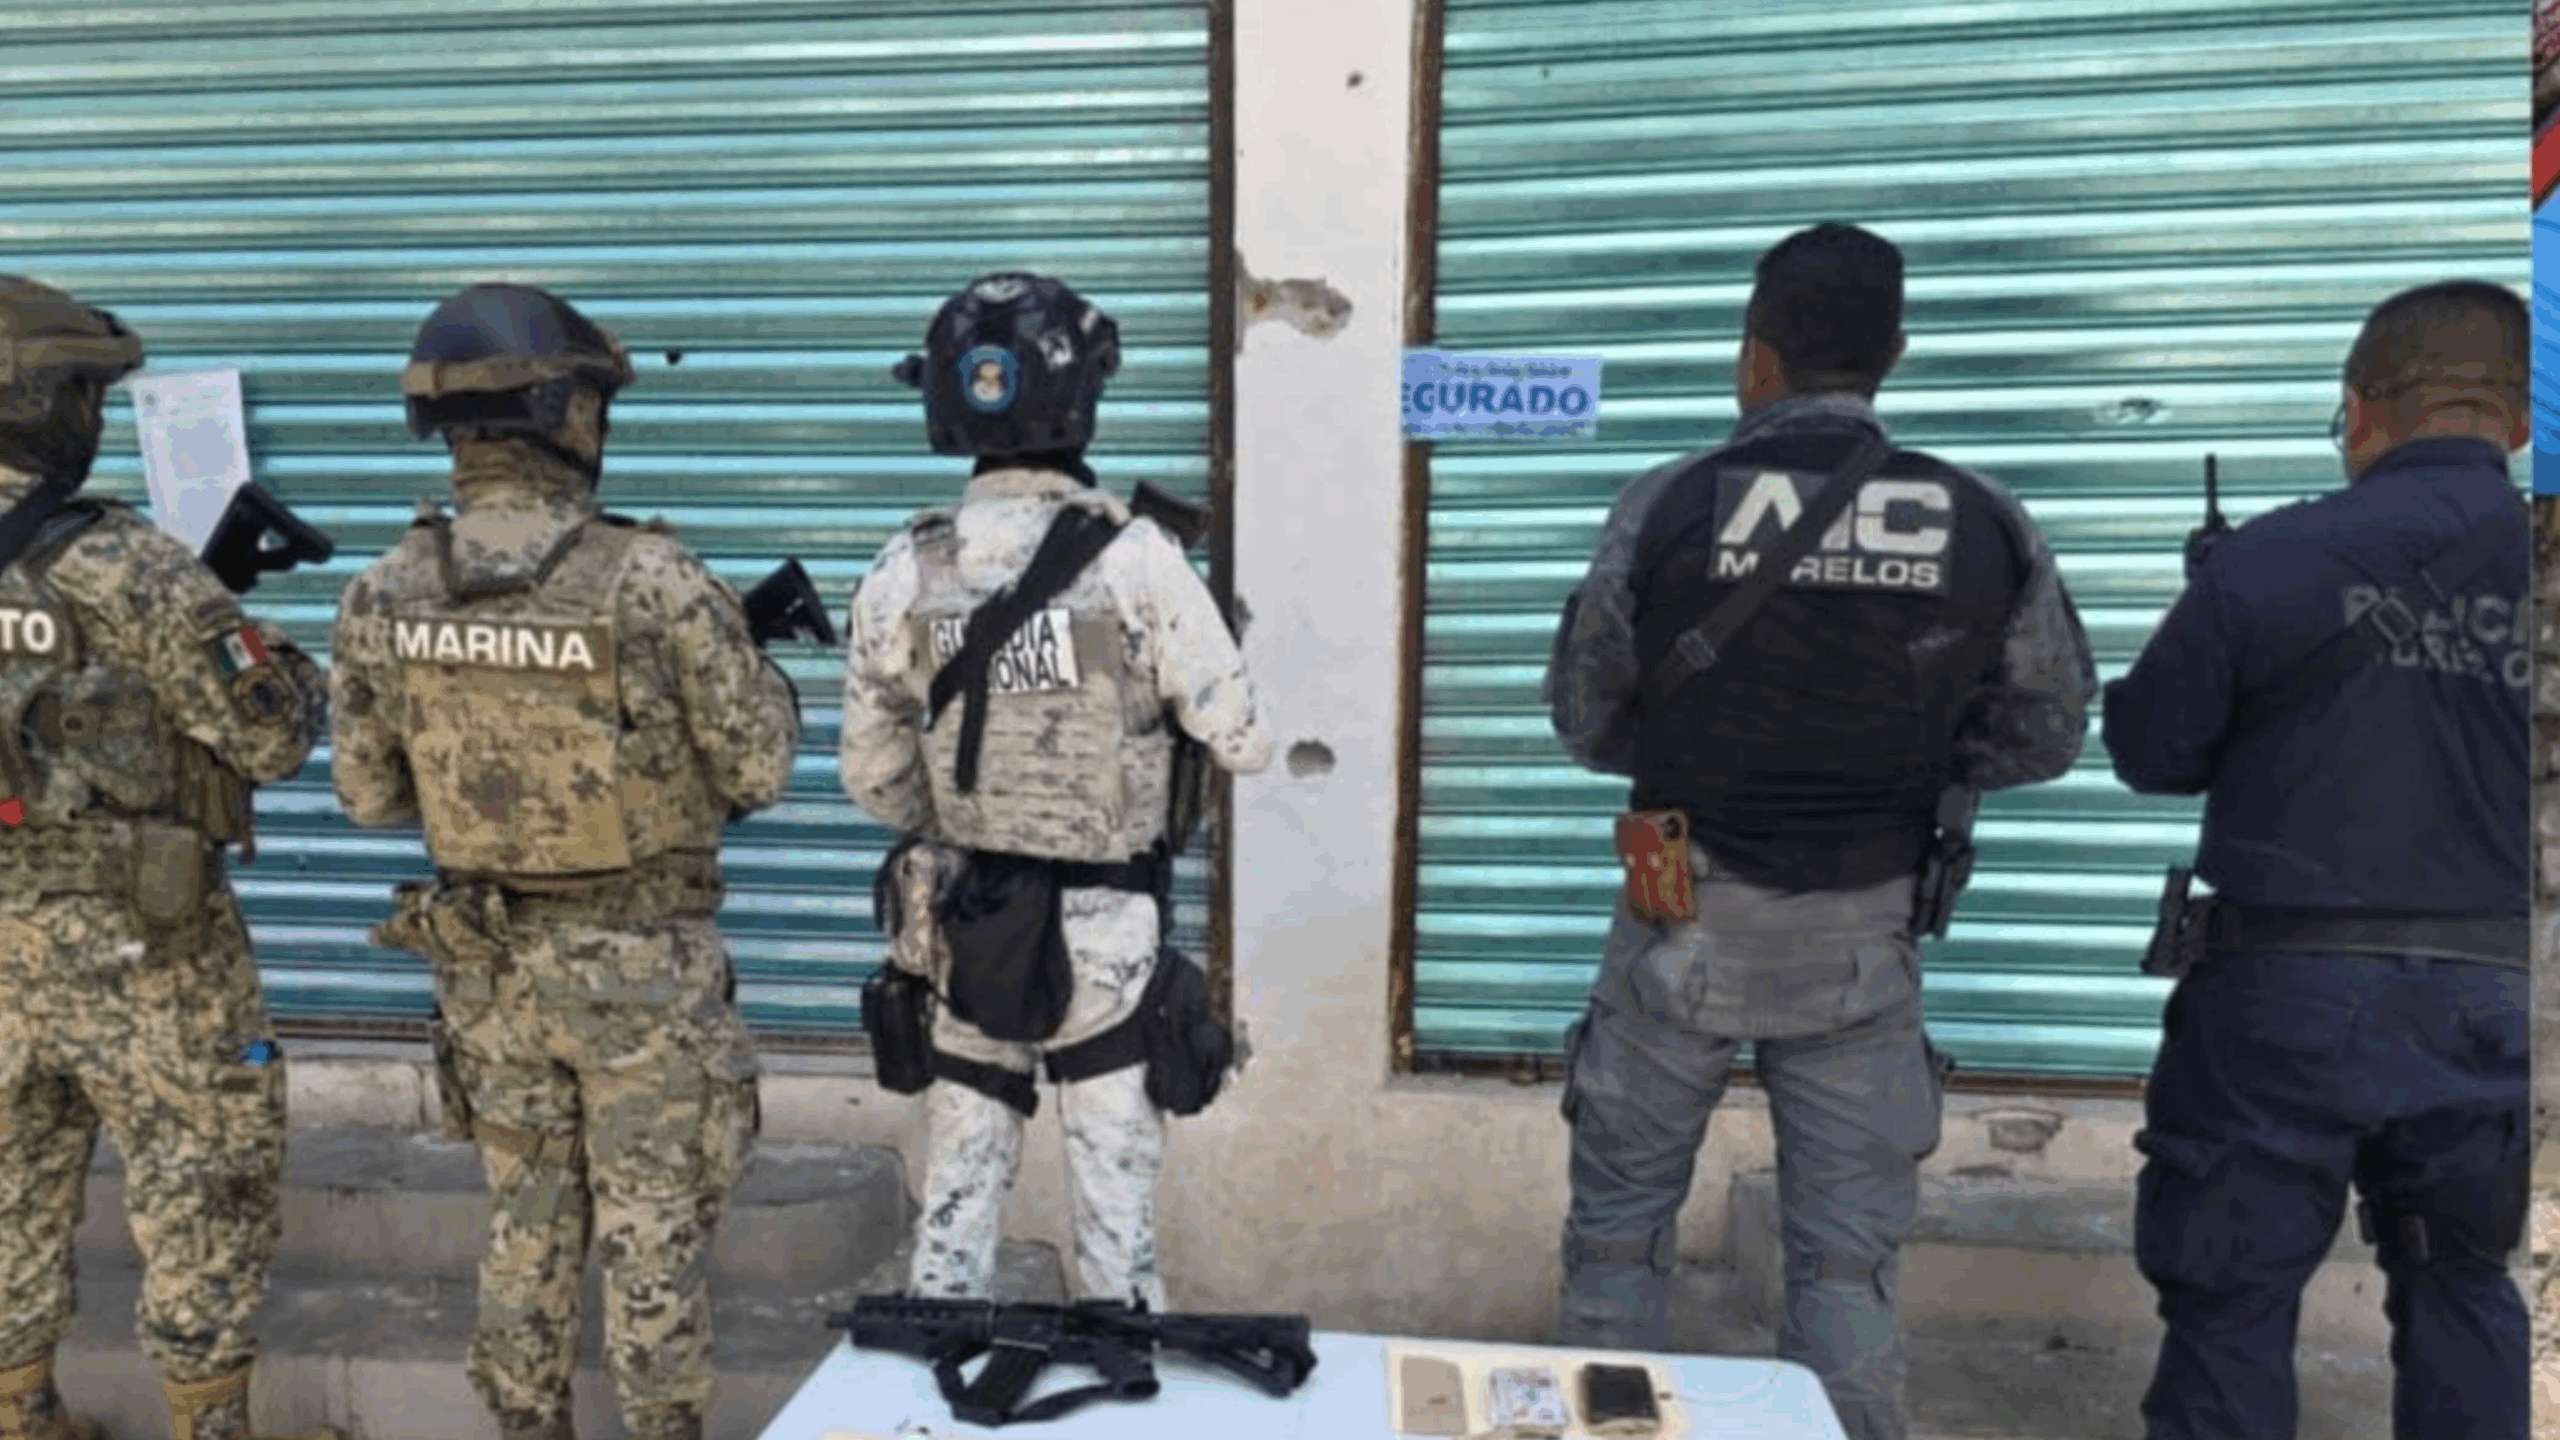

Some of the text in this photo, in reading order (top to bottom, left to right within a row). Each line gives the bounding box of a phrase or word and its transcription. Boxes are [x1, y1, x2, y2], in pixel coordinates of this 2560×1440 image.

[1717, 549, 1941, 590] MRELOS
[0, 609, 55, 653] TO
[395, 610, 595, 671] MARINA
